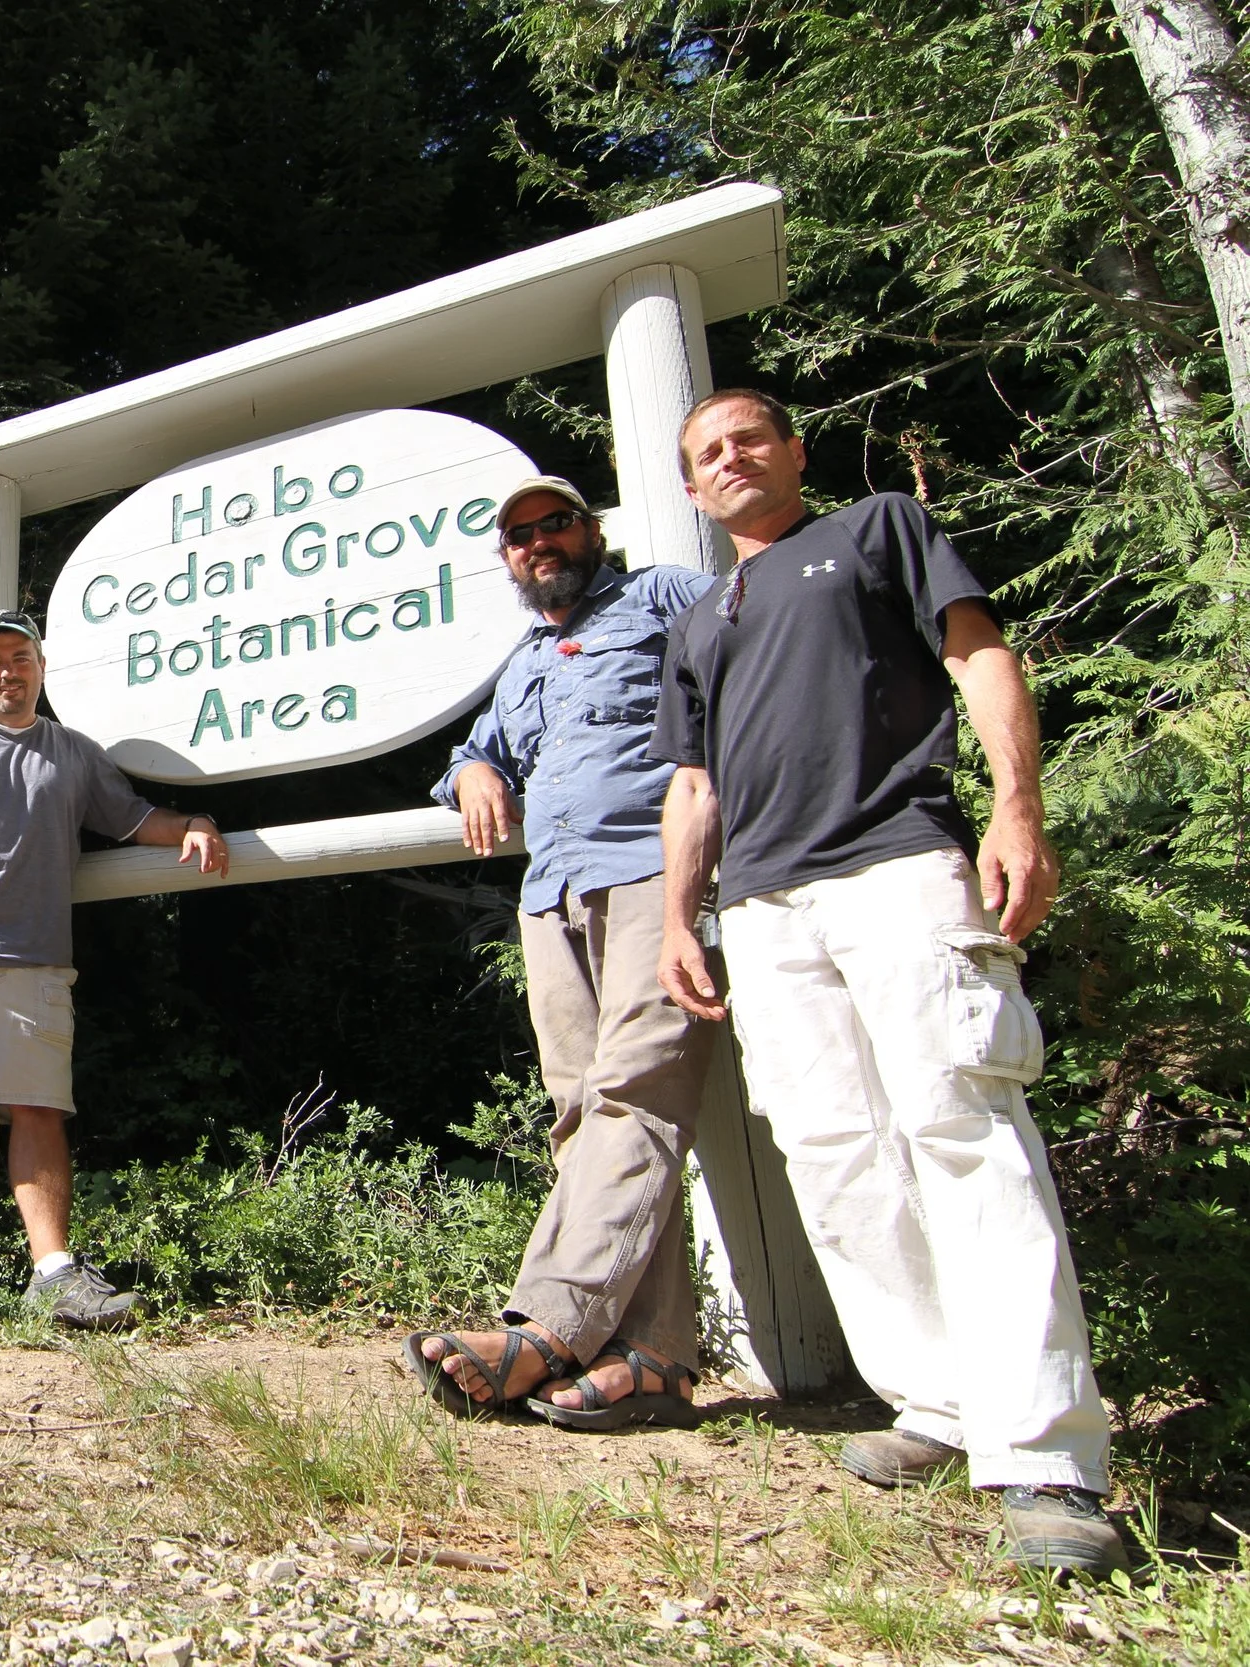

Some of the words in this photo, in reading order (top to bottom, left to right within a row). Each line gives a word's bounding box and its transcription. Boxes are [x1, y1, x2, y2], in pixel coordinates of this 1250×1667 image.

[171, 464, 365, 544] Hobo
[82, 552, 265, 624] Cedar
[282, 497, 498, 577] Grove
[127, 562, 455, 688] Botanical
[188, 684, 358, 748] Area
